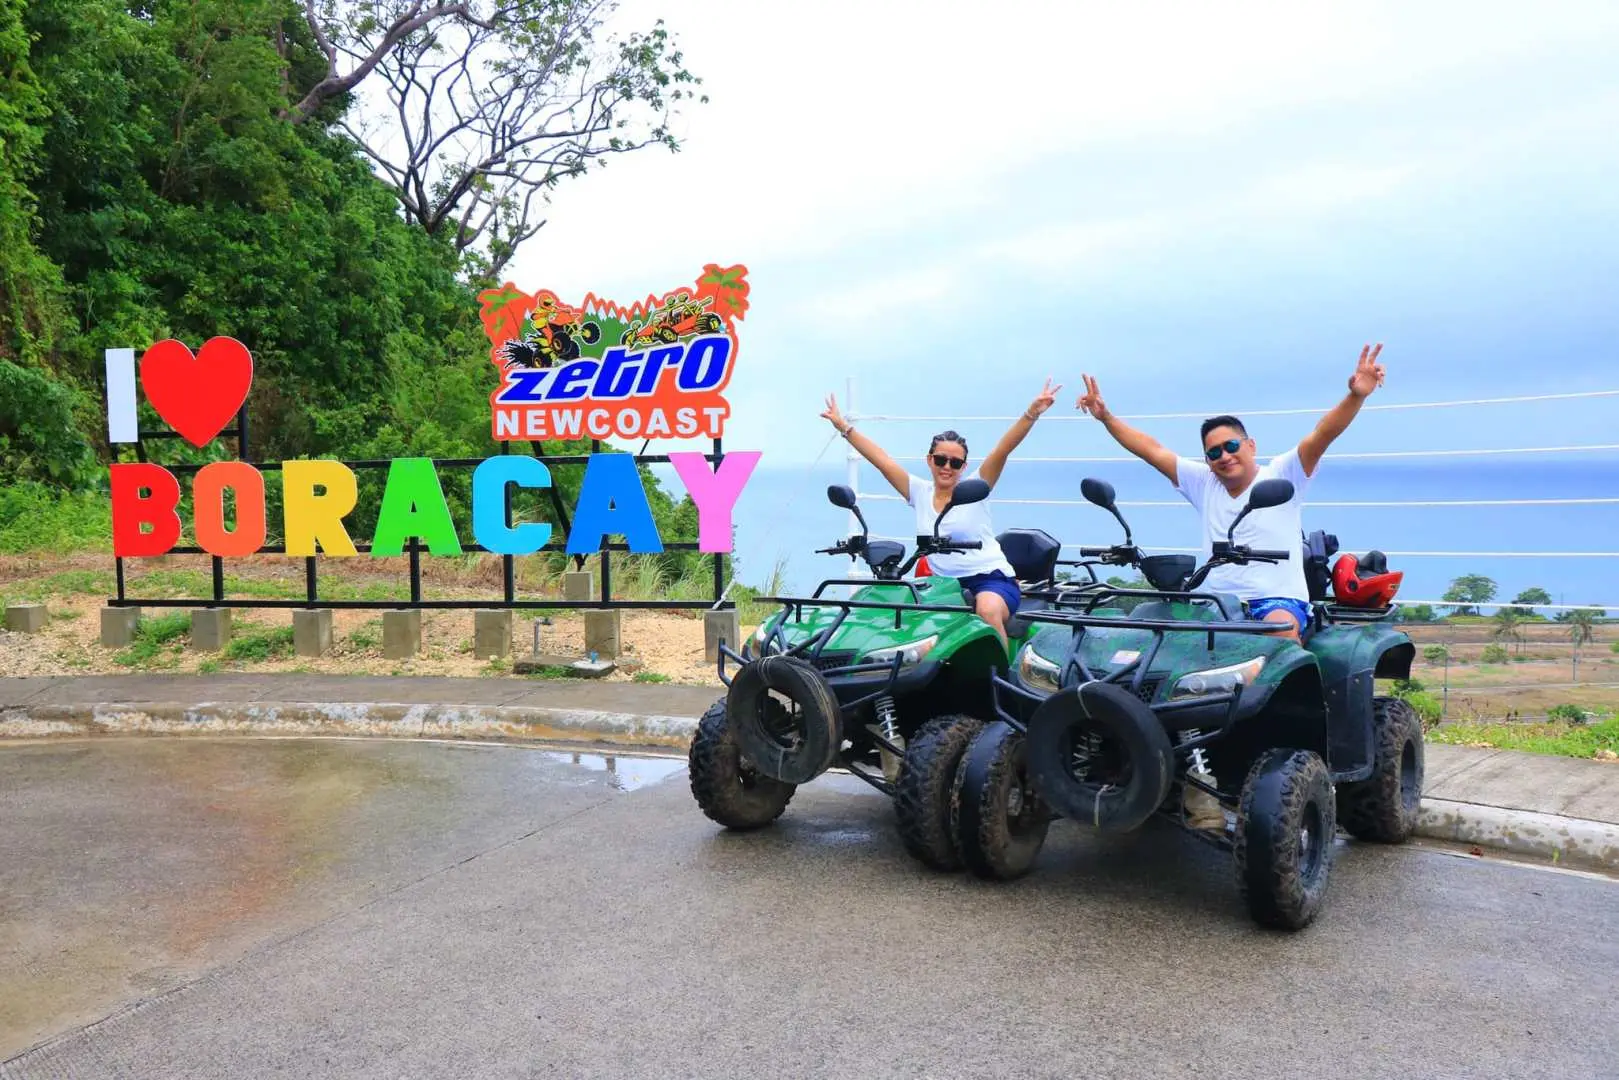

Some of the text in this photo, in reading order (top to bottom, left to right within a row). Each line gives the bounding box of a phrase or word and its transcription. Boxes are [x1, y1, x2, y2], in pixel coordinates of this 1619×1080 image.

[105, 347, 138, 443] I
[496, 407, 726, 436] NEWCOAST
[109, 451, 762, 557] BORACAY
